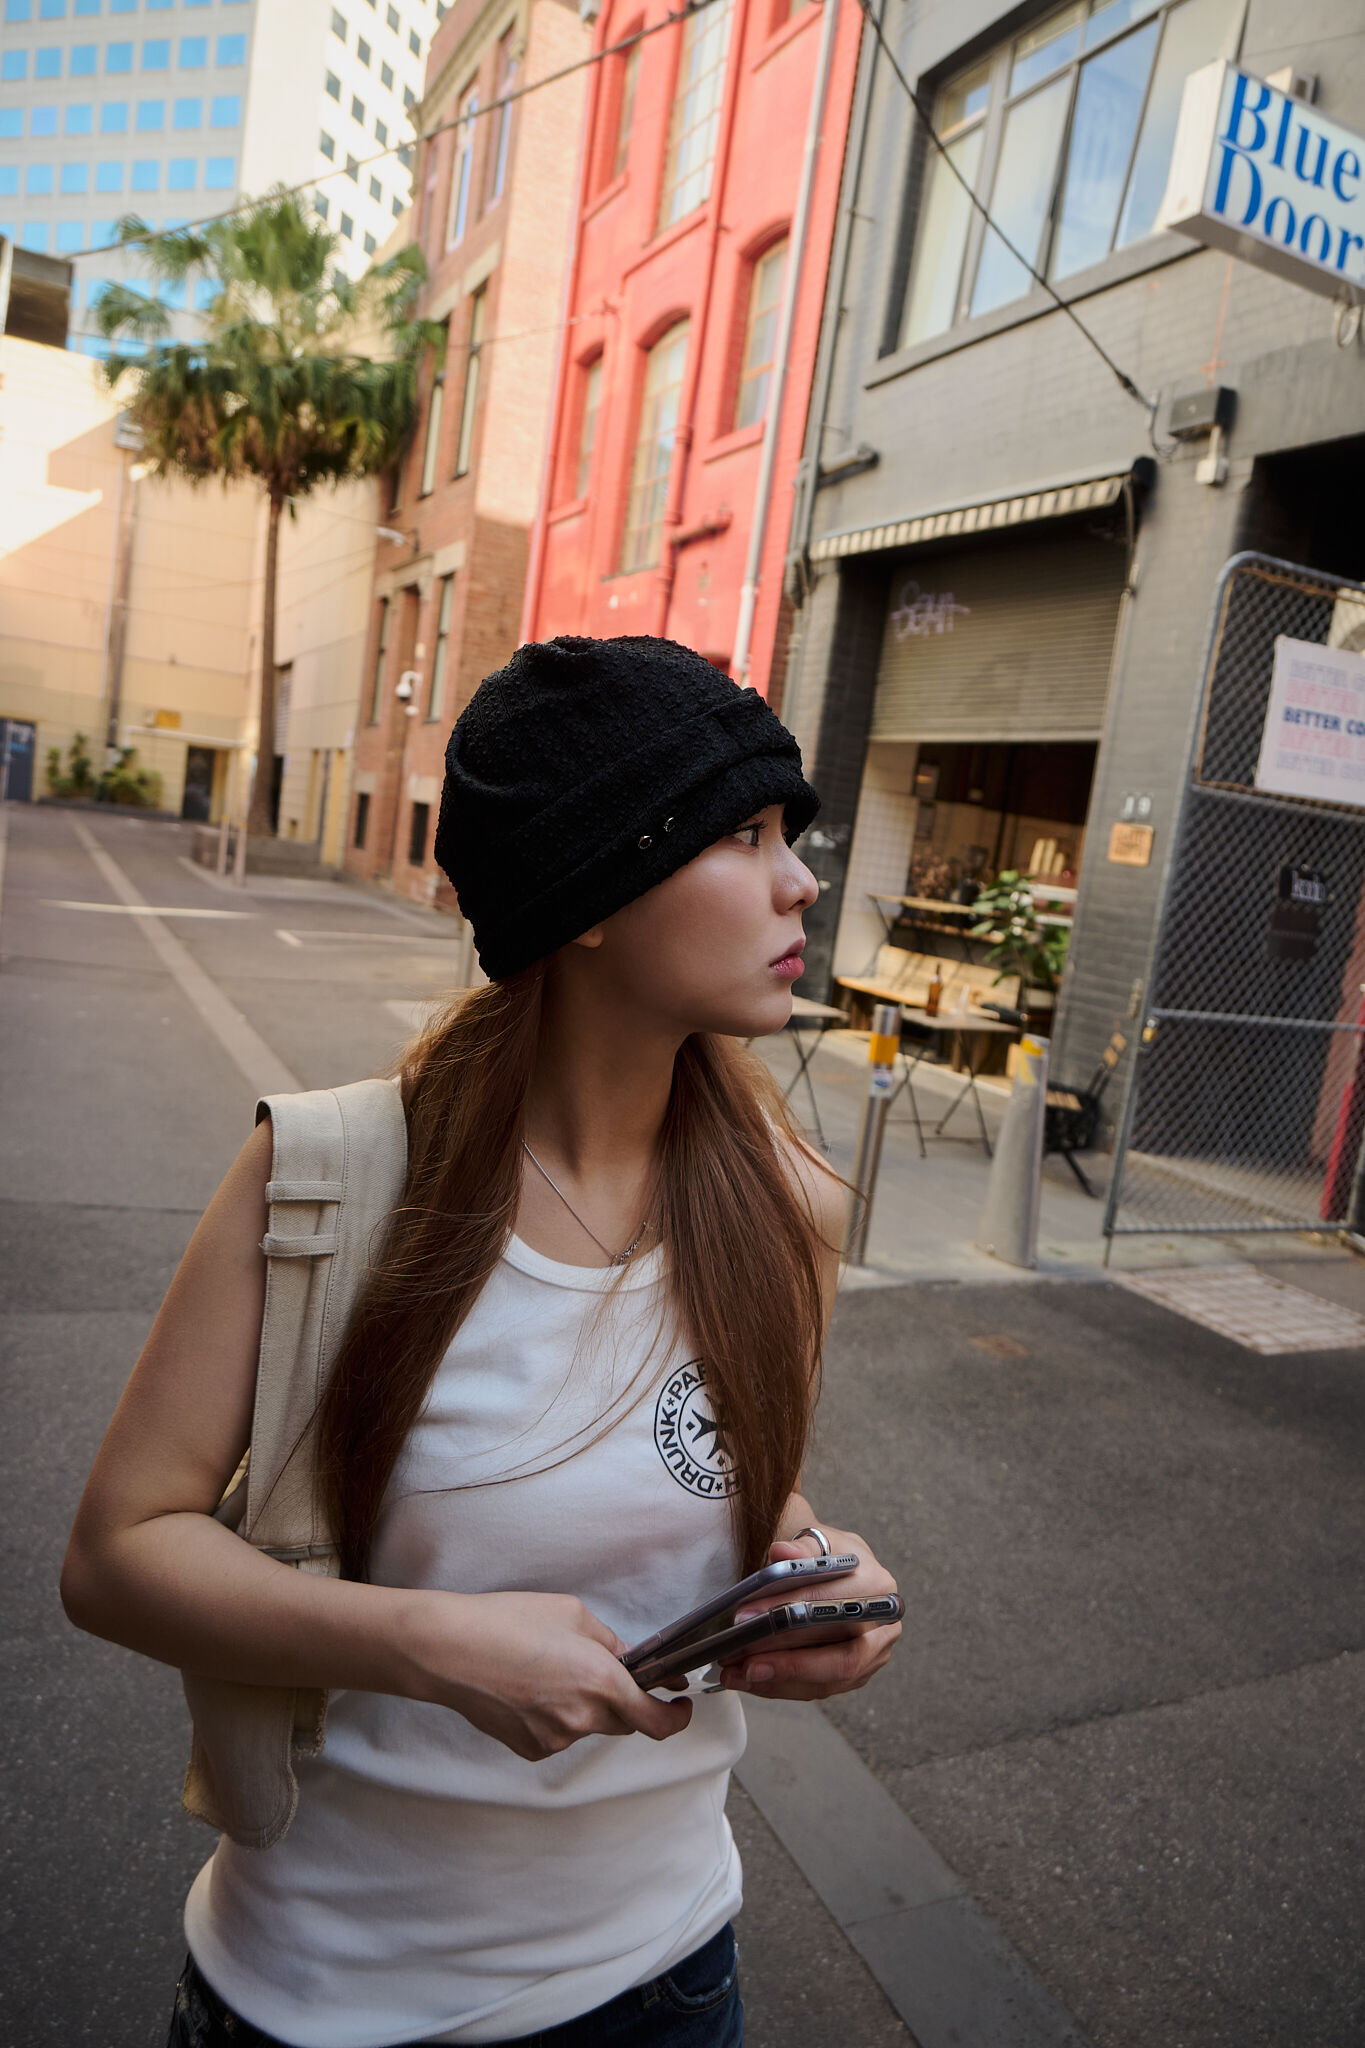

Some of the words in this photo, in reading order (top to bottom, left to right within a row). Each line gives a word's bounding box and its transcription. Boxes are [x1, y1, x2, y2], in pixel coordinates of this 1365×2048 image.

[1218, 72, 1361, 203] Blue
[1213, 144, 1365, 271] Door
[1283, 706, 1341, 731] BETTER
[660, 1406, 716, 1493] DRUNK
